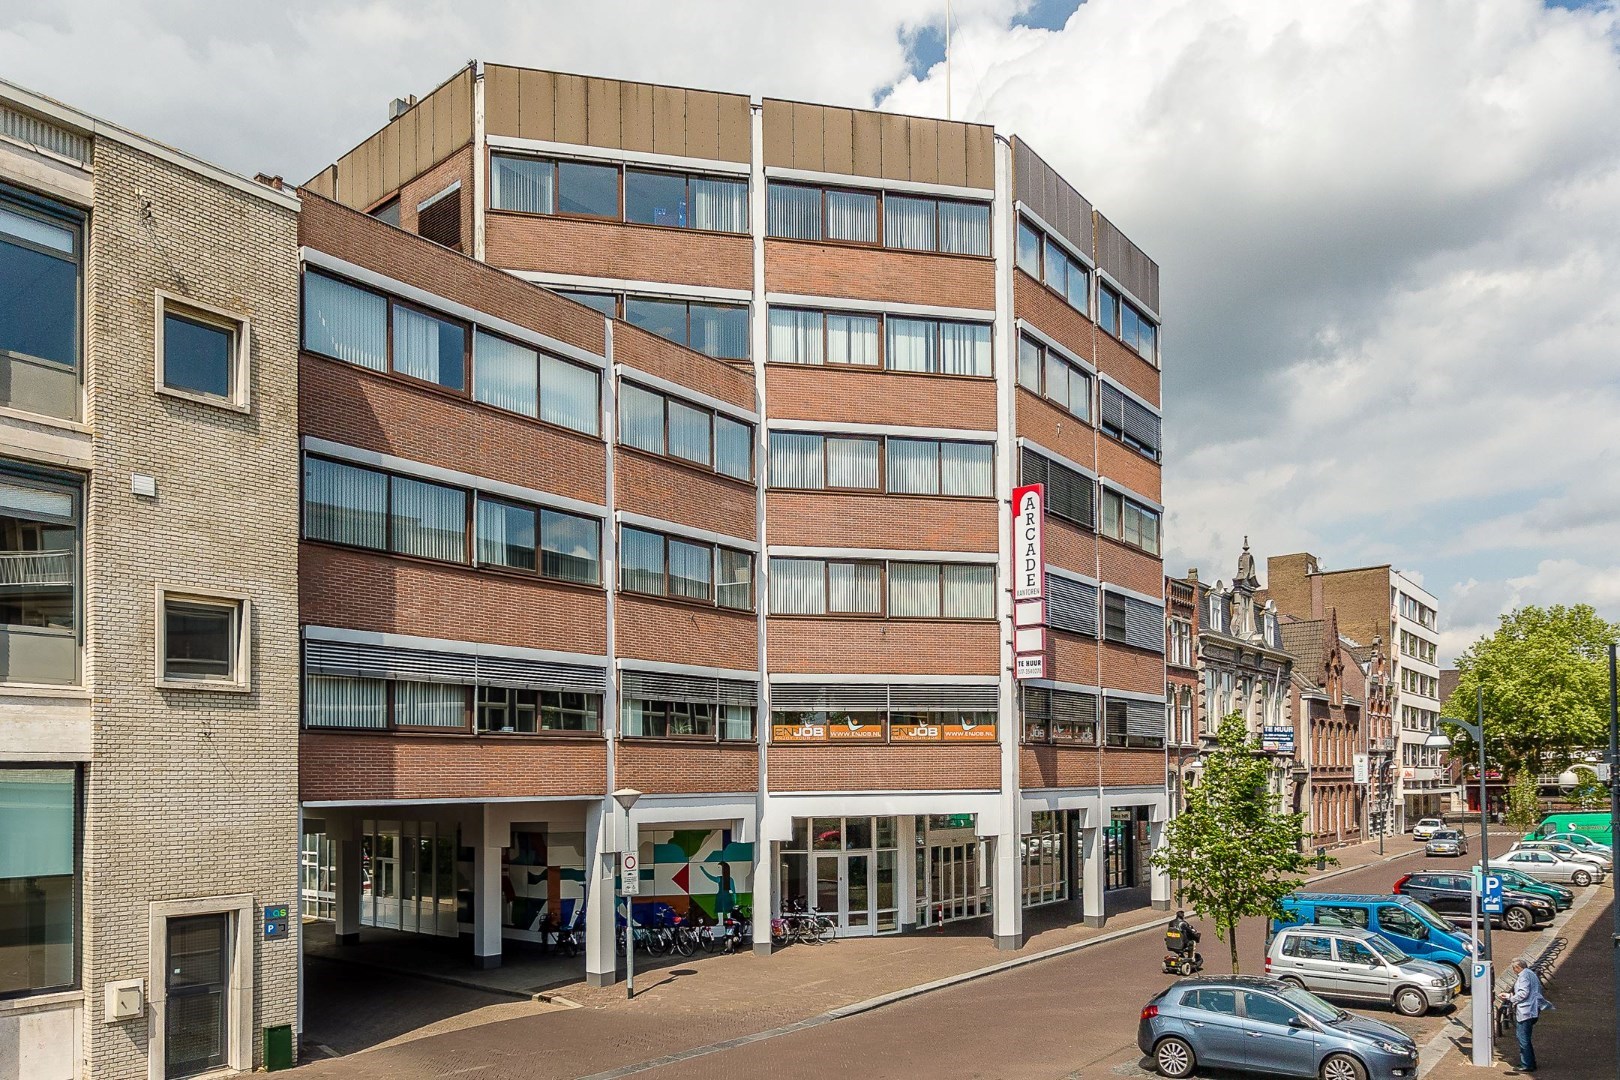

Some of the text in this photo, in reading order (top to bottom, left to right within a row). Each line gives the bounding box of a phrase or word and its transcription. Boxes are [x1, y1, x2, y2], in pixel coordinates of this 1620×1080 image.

[1024, 496, 1037, 587] ARCADE
[1025, 659, 1042, 667] HUUR
[775, 727, 824, 737] ENJOB
[891, 727, 939, 737] ENJOB
[1486, 877, 1499, 895] P
[267, 924, 274, 933] P
[1474, 965, 1483, 976] P
